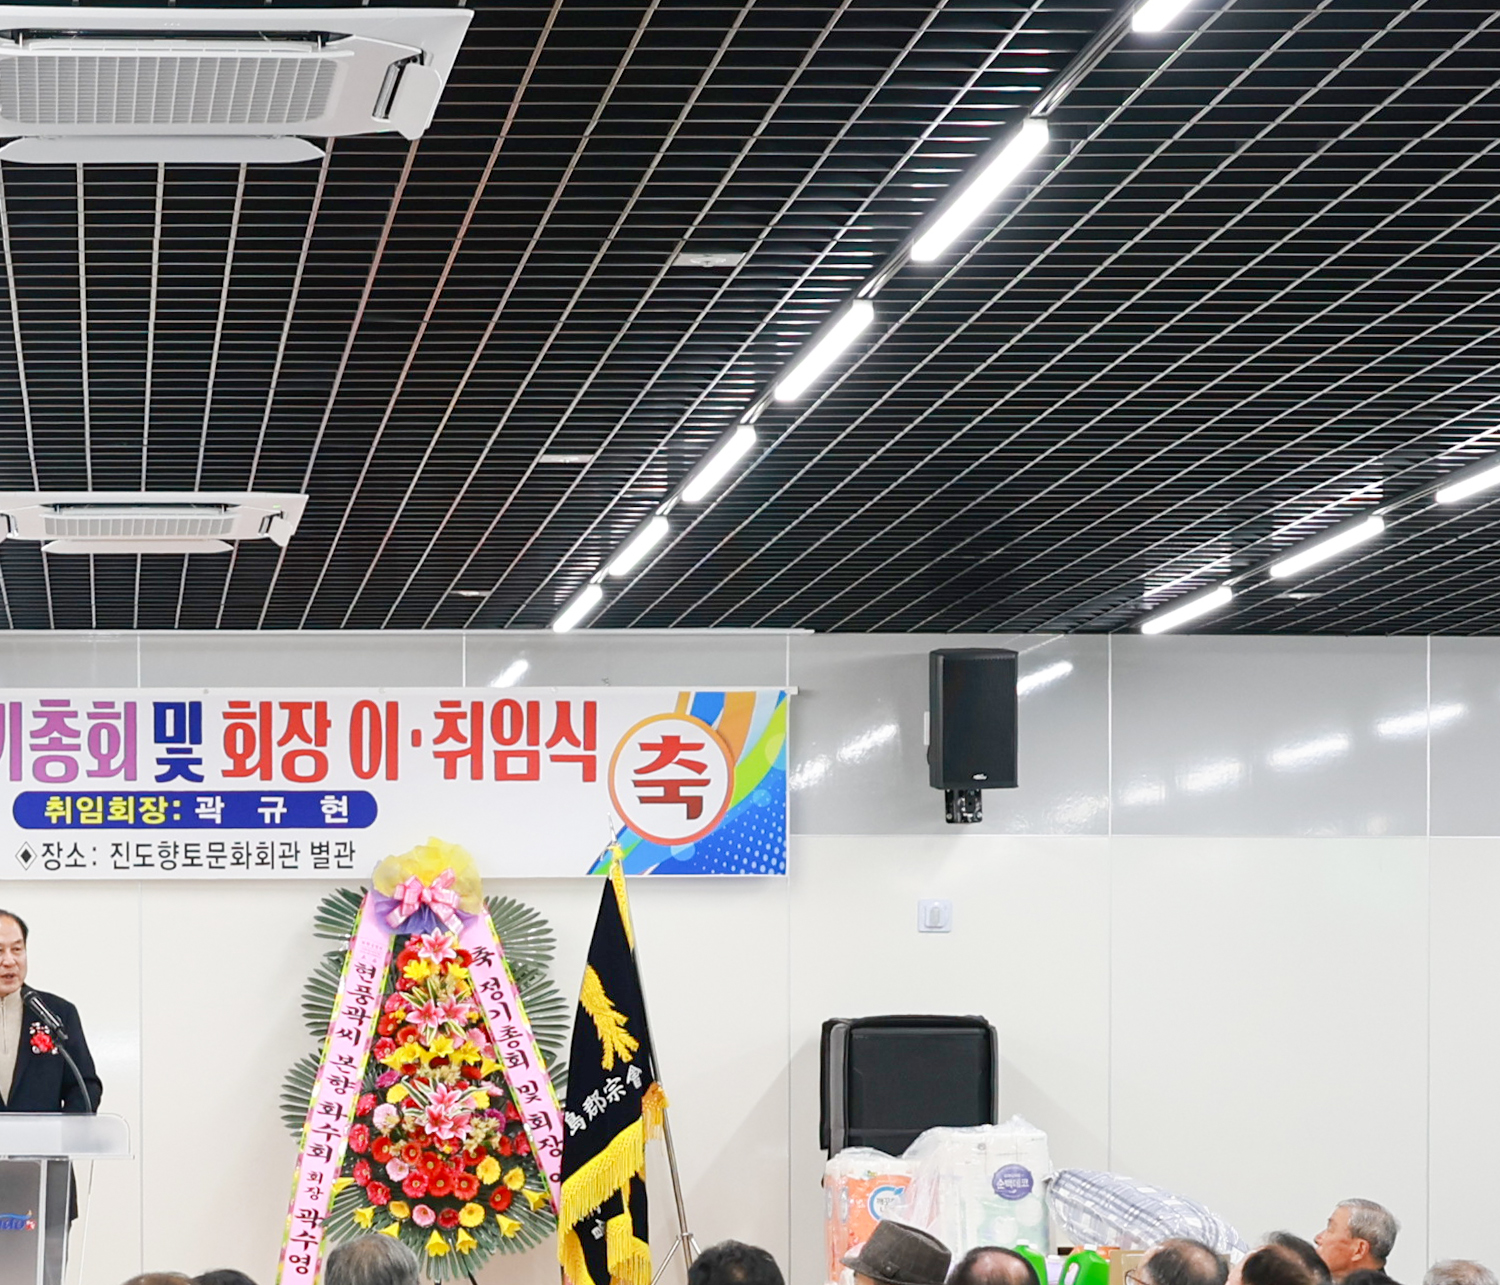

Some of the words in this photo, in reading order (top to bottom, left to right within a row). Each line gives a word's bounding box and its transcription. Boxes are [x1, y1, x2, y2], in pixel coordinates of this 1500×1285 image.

[152, 701, 205, 784] 및
[221, 700, 332, 784] 회장
[349, 698, 597, 783] 이·취임식
[631, 735, 711, 821] 축
[44, 796, 180, 824] 취임회장:
[42, 841, 98, 871] 장소:
[110, 840, 301, 871] 진도향토문화회관
[310, 840, 356, 870] 별관
[471, 946, 495, 968] 축
[335, 962, 377, 1047] 현풍곽씨
[479, 976, 531, 1071] 정기총회
[326, 1054, 358, 1095] 본향
[516, 1080, 543, 1104] 및
[306, 1102, 348, 1164] 화수회
[527, 1111, 563, 1158] 회장
[303, 1171, 324, 1201] 회장
[289, 1208, 325, 1275] 곽수영
